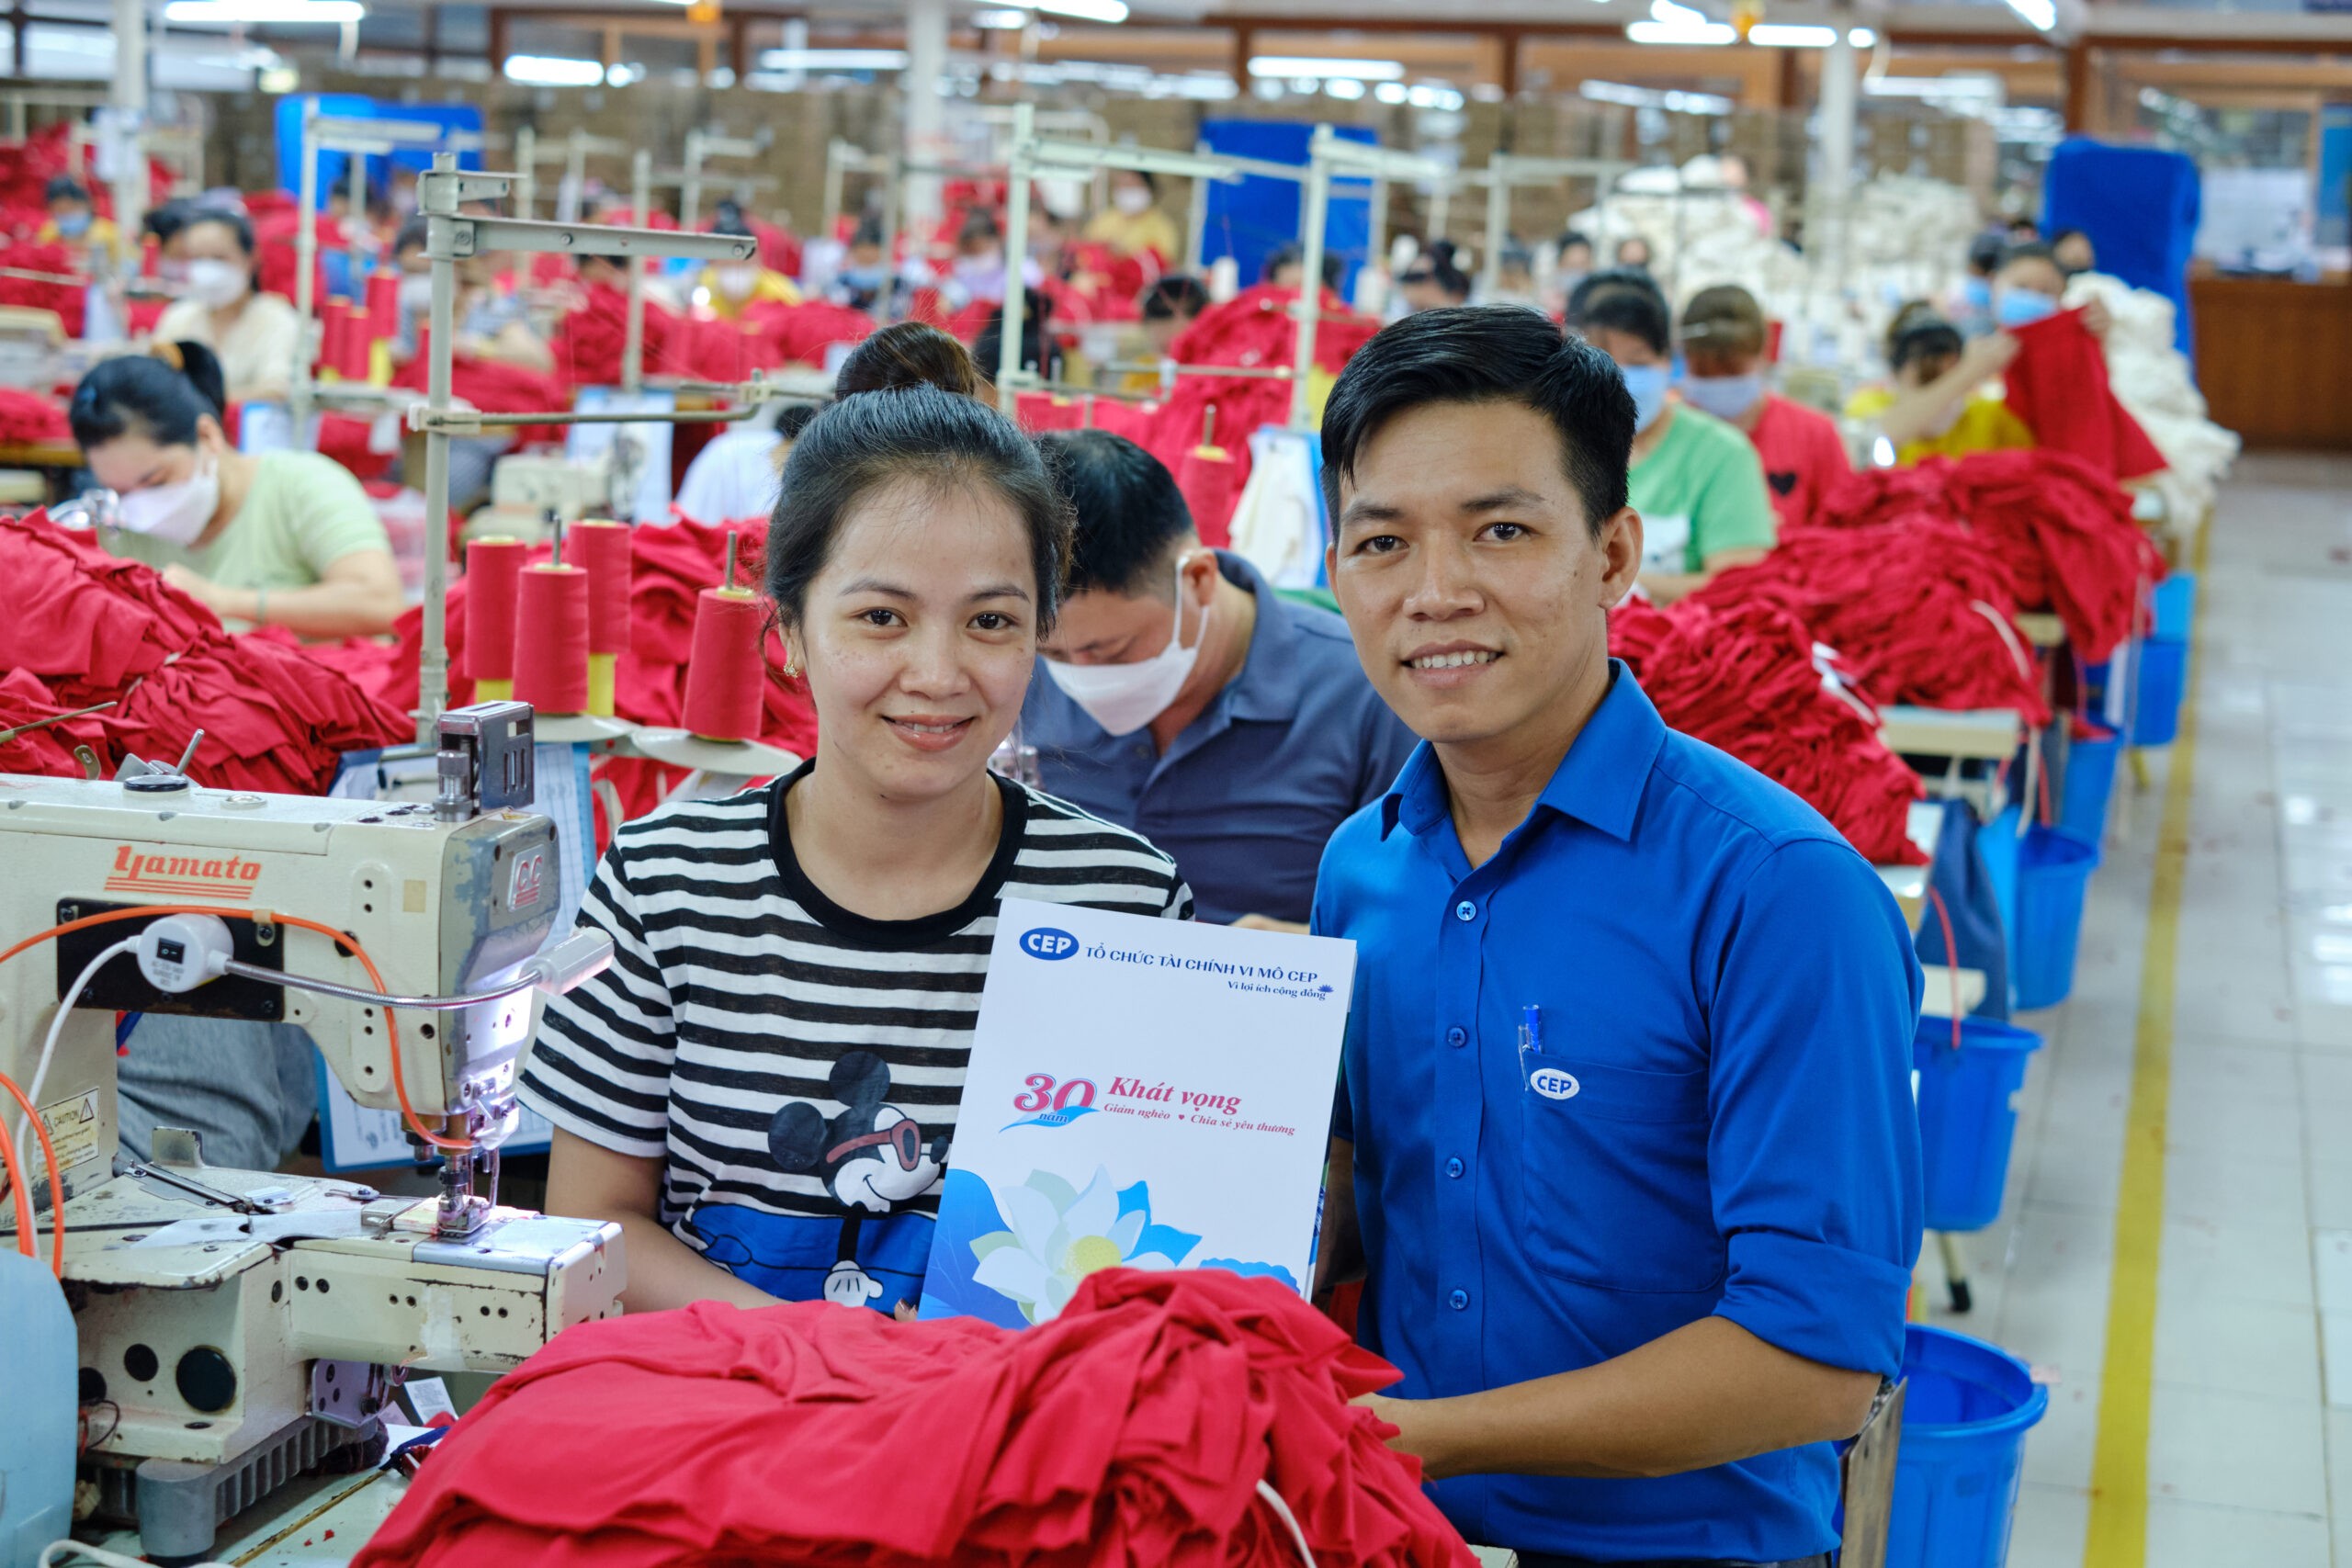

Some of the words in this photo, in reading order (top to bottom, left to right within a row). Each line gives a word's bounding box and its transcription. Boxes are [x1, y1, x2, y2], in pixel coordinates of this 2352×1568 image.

[114, 845, 262, 881] Yamato
[1026, 932, 1072, 955] CEP
[1085, 942, 1106, 959] TỔ
[1110, 950, 1154, 965] CHỨC
[1159, 953, 1182, 968] TÀI
[1185, 958, 1236, 975] CHÍNH
[1239, 964, 1253, 977] VI
[1257, 965, 1284, 980] MÔ
[1287, 970, 1318, 983] CEP
[1255, 983, 1272, 993] ích
[1272, 987, 1298, 998] cộng
[1013, 1073, 1098, 1112] 30
[1106, 1076, 1174, 1103] Khát
[1182, 1089, 1242, 1116] vọng
[1536, 1075, 1572, 1094] CEP
[1038, 1112, 1068, 1123] năm
[1137, 1109, 1170, 1120] nghèo
[1191, 1114, 1217, 1126] Chia
[1233, 1121, 1254, 1131] yêu
[1256, 1122, 1295, 1136] thương
